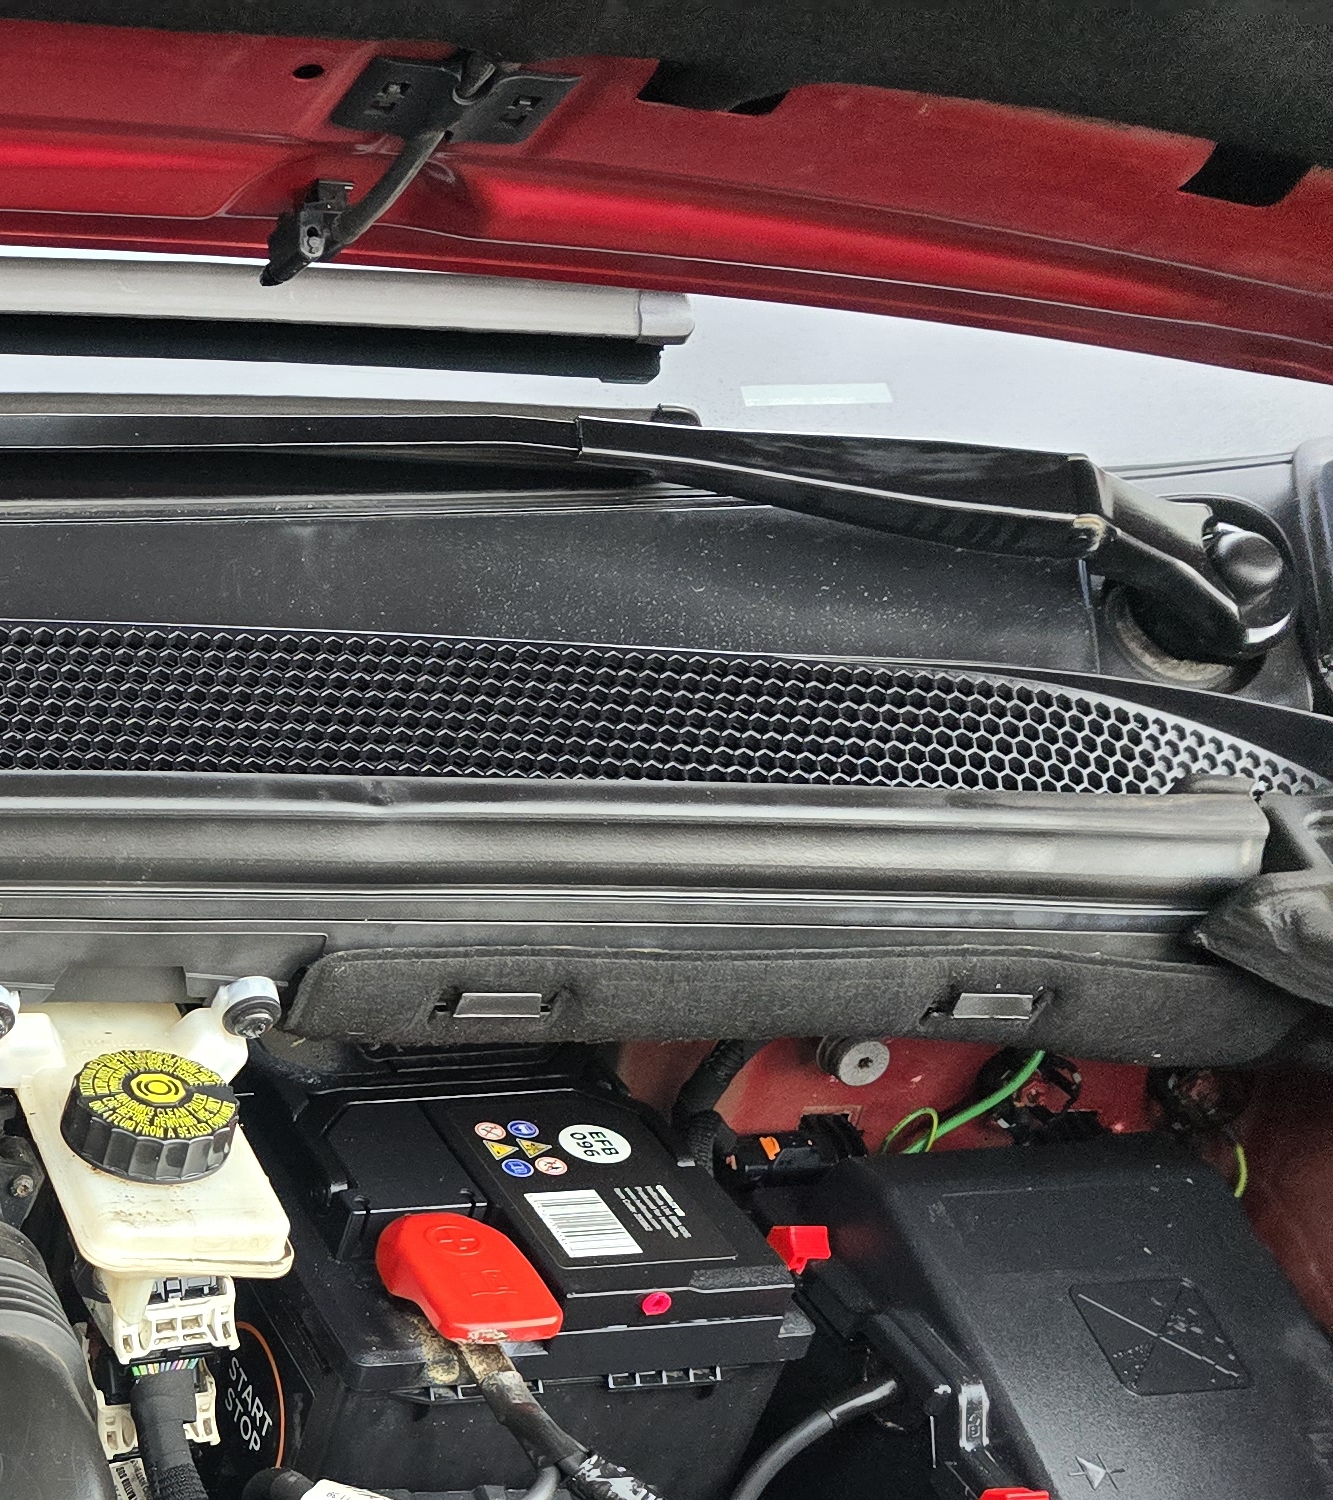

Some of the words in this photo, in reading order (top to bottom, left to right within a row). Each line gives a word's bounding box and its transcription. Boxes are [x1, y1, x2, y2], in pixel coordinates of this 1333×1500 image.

[116, 1106, 153, 1125] BEFORE
[156, 1107, 190, 1118] CLEAN
[106, 1113, 136, 1132] FLUID
[135, 1123, 164, 1138] FROM
[167, 1127, 176, 1138] A
[588, 1131, 620, 1157] EFB
[229, 1357, 273, 1437] START
[225, 1387, 261, 1452] STOP
